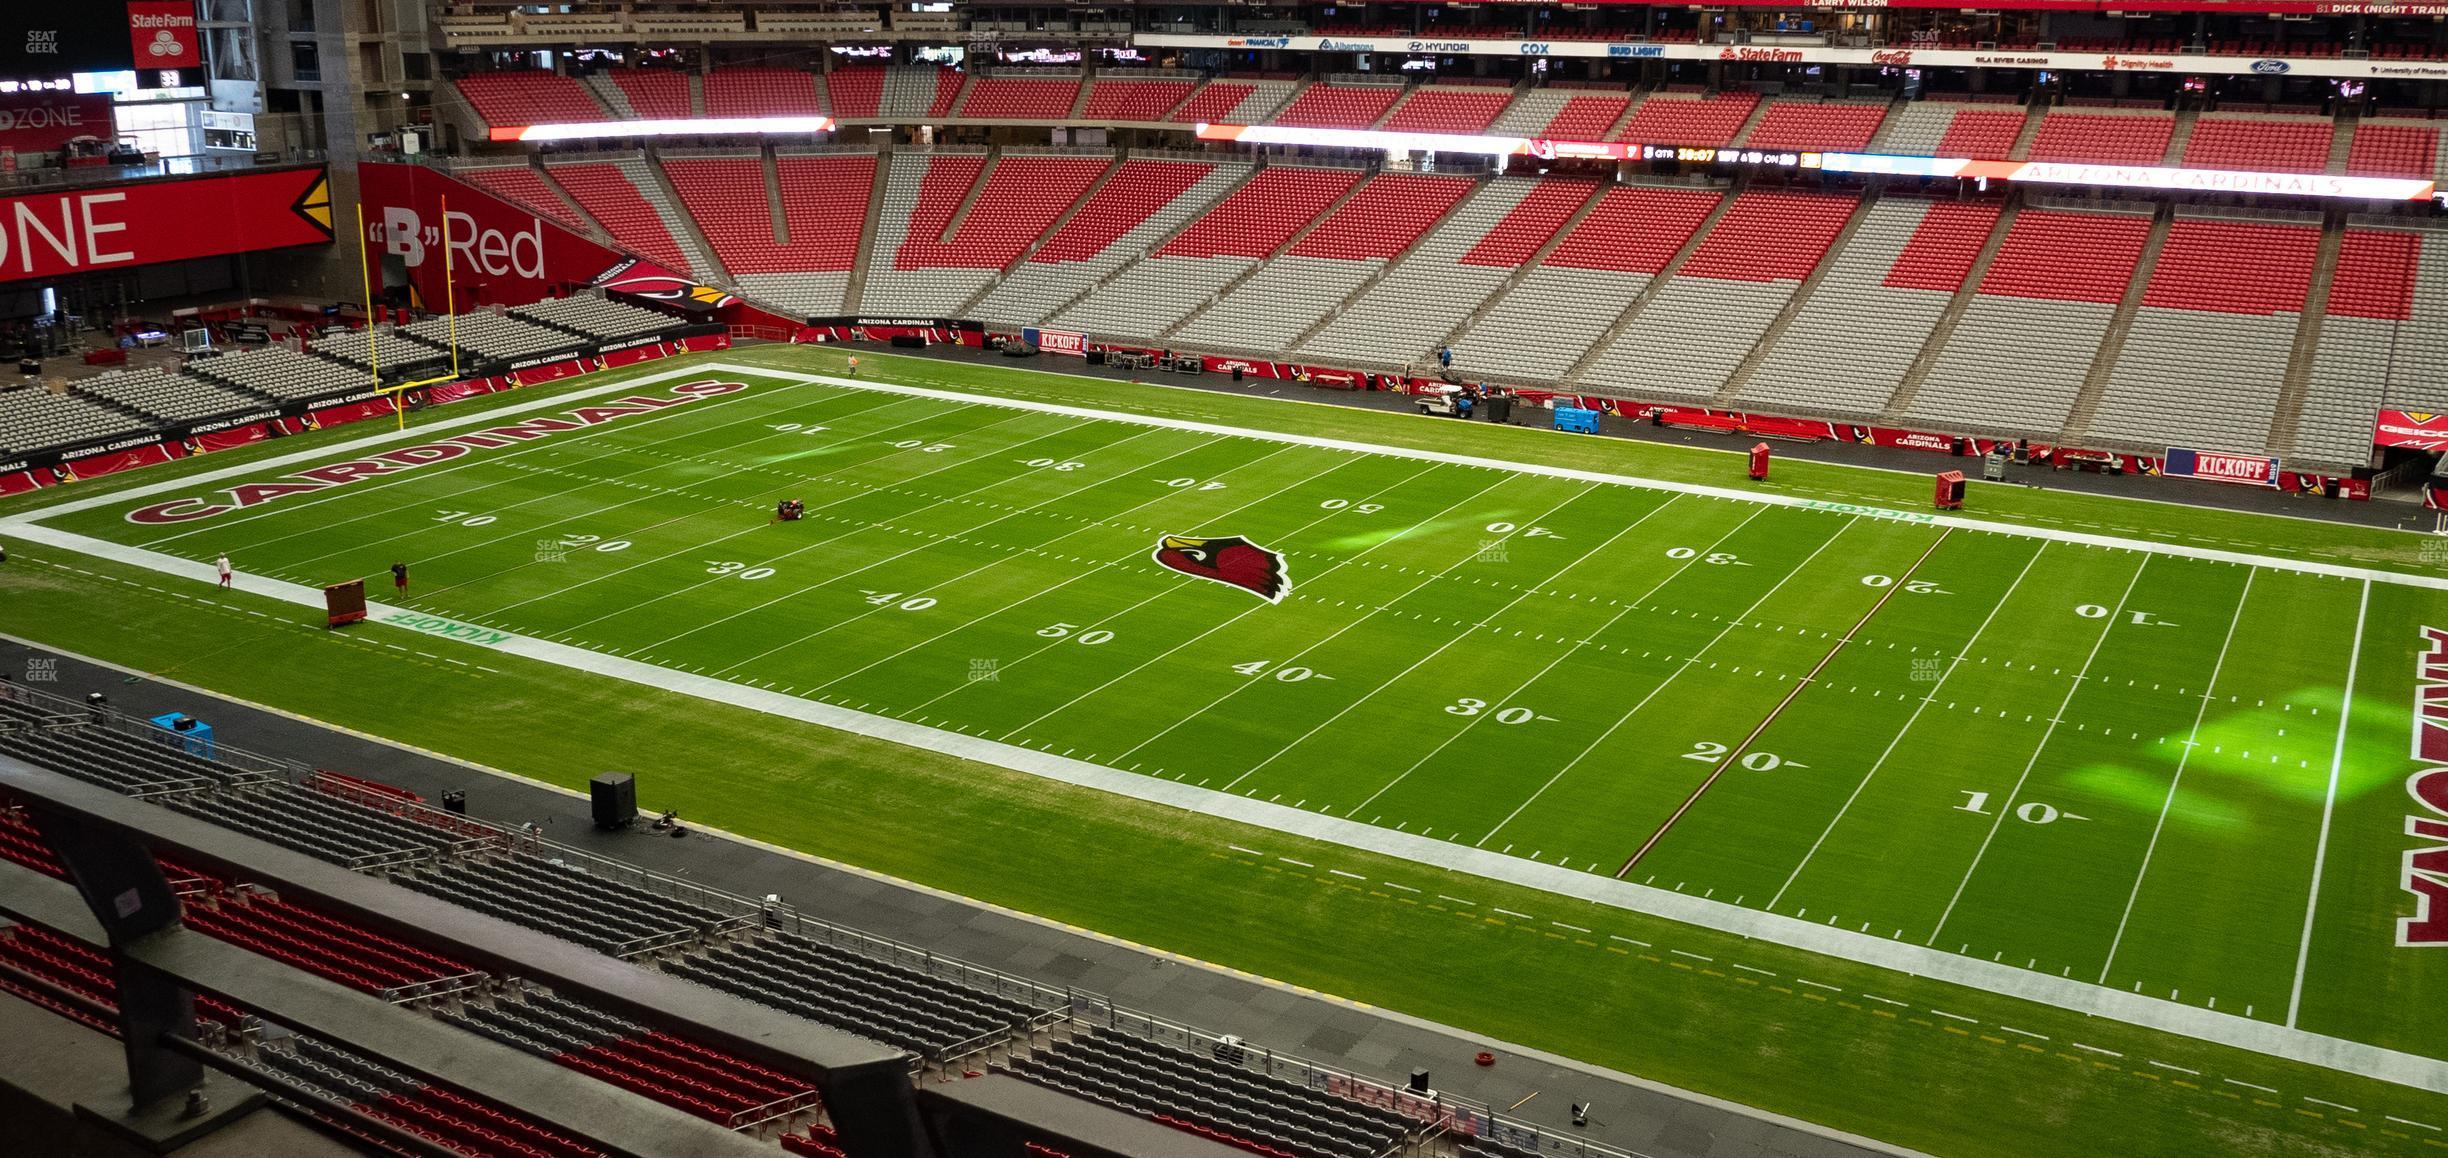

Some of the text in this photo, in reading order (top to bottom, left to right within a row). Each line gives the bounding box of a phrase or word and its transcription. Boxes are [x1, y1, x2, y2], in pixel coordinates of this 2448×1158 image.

[2332, 4, 2361, 13] DICK
[2364, 5, 2408, 14] (NIGHT
[1426, 42, 1470, 52] HYUNDAI
[1520, 43, 1549, 54] COX
[1610, 46, 1663, 56] BUD LIGHT
[2121, 60, 2173, 69] Dignity Health
[1655, 150, 1674, 159] QTR
[2171, 172, 2342, 193] CARDINALS
[0, 192, 134, 272] NE
[444, 211, 545, 279] Red
[892, 318, 934, 326] CARDINALS
[599, 335, 661, 352] ARIZONA CARDINALS
[1041, 333, 1081, 350] KICKOFF
[510, 351, 579, 369] ARIZONA CARDINALS
[308, 397, 345, 410] ARIZONA
[190, 409, 281, 434] ARIZONA CARDINALS
[61, 445, 106, 460] ARIZONA
[107, 433, 162, 450] CARDINALS
[1895, 438, 1951, 450] CARDINALS
[1907, 434, 1941, 442] ARIZONA
[125, 379, 749, 525] CARDINALS
[2198, 455, 2266, 479] KICKOFF
[382, 613, 513, 645] KICKOFF
